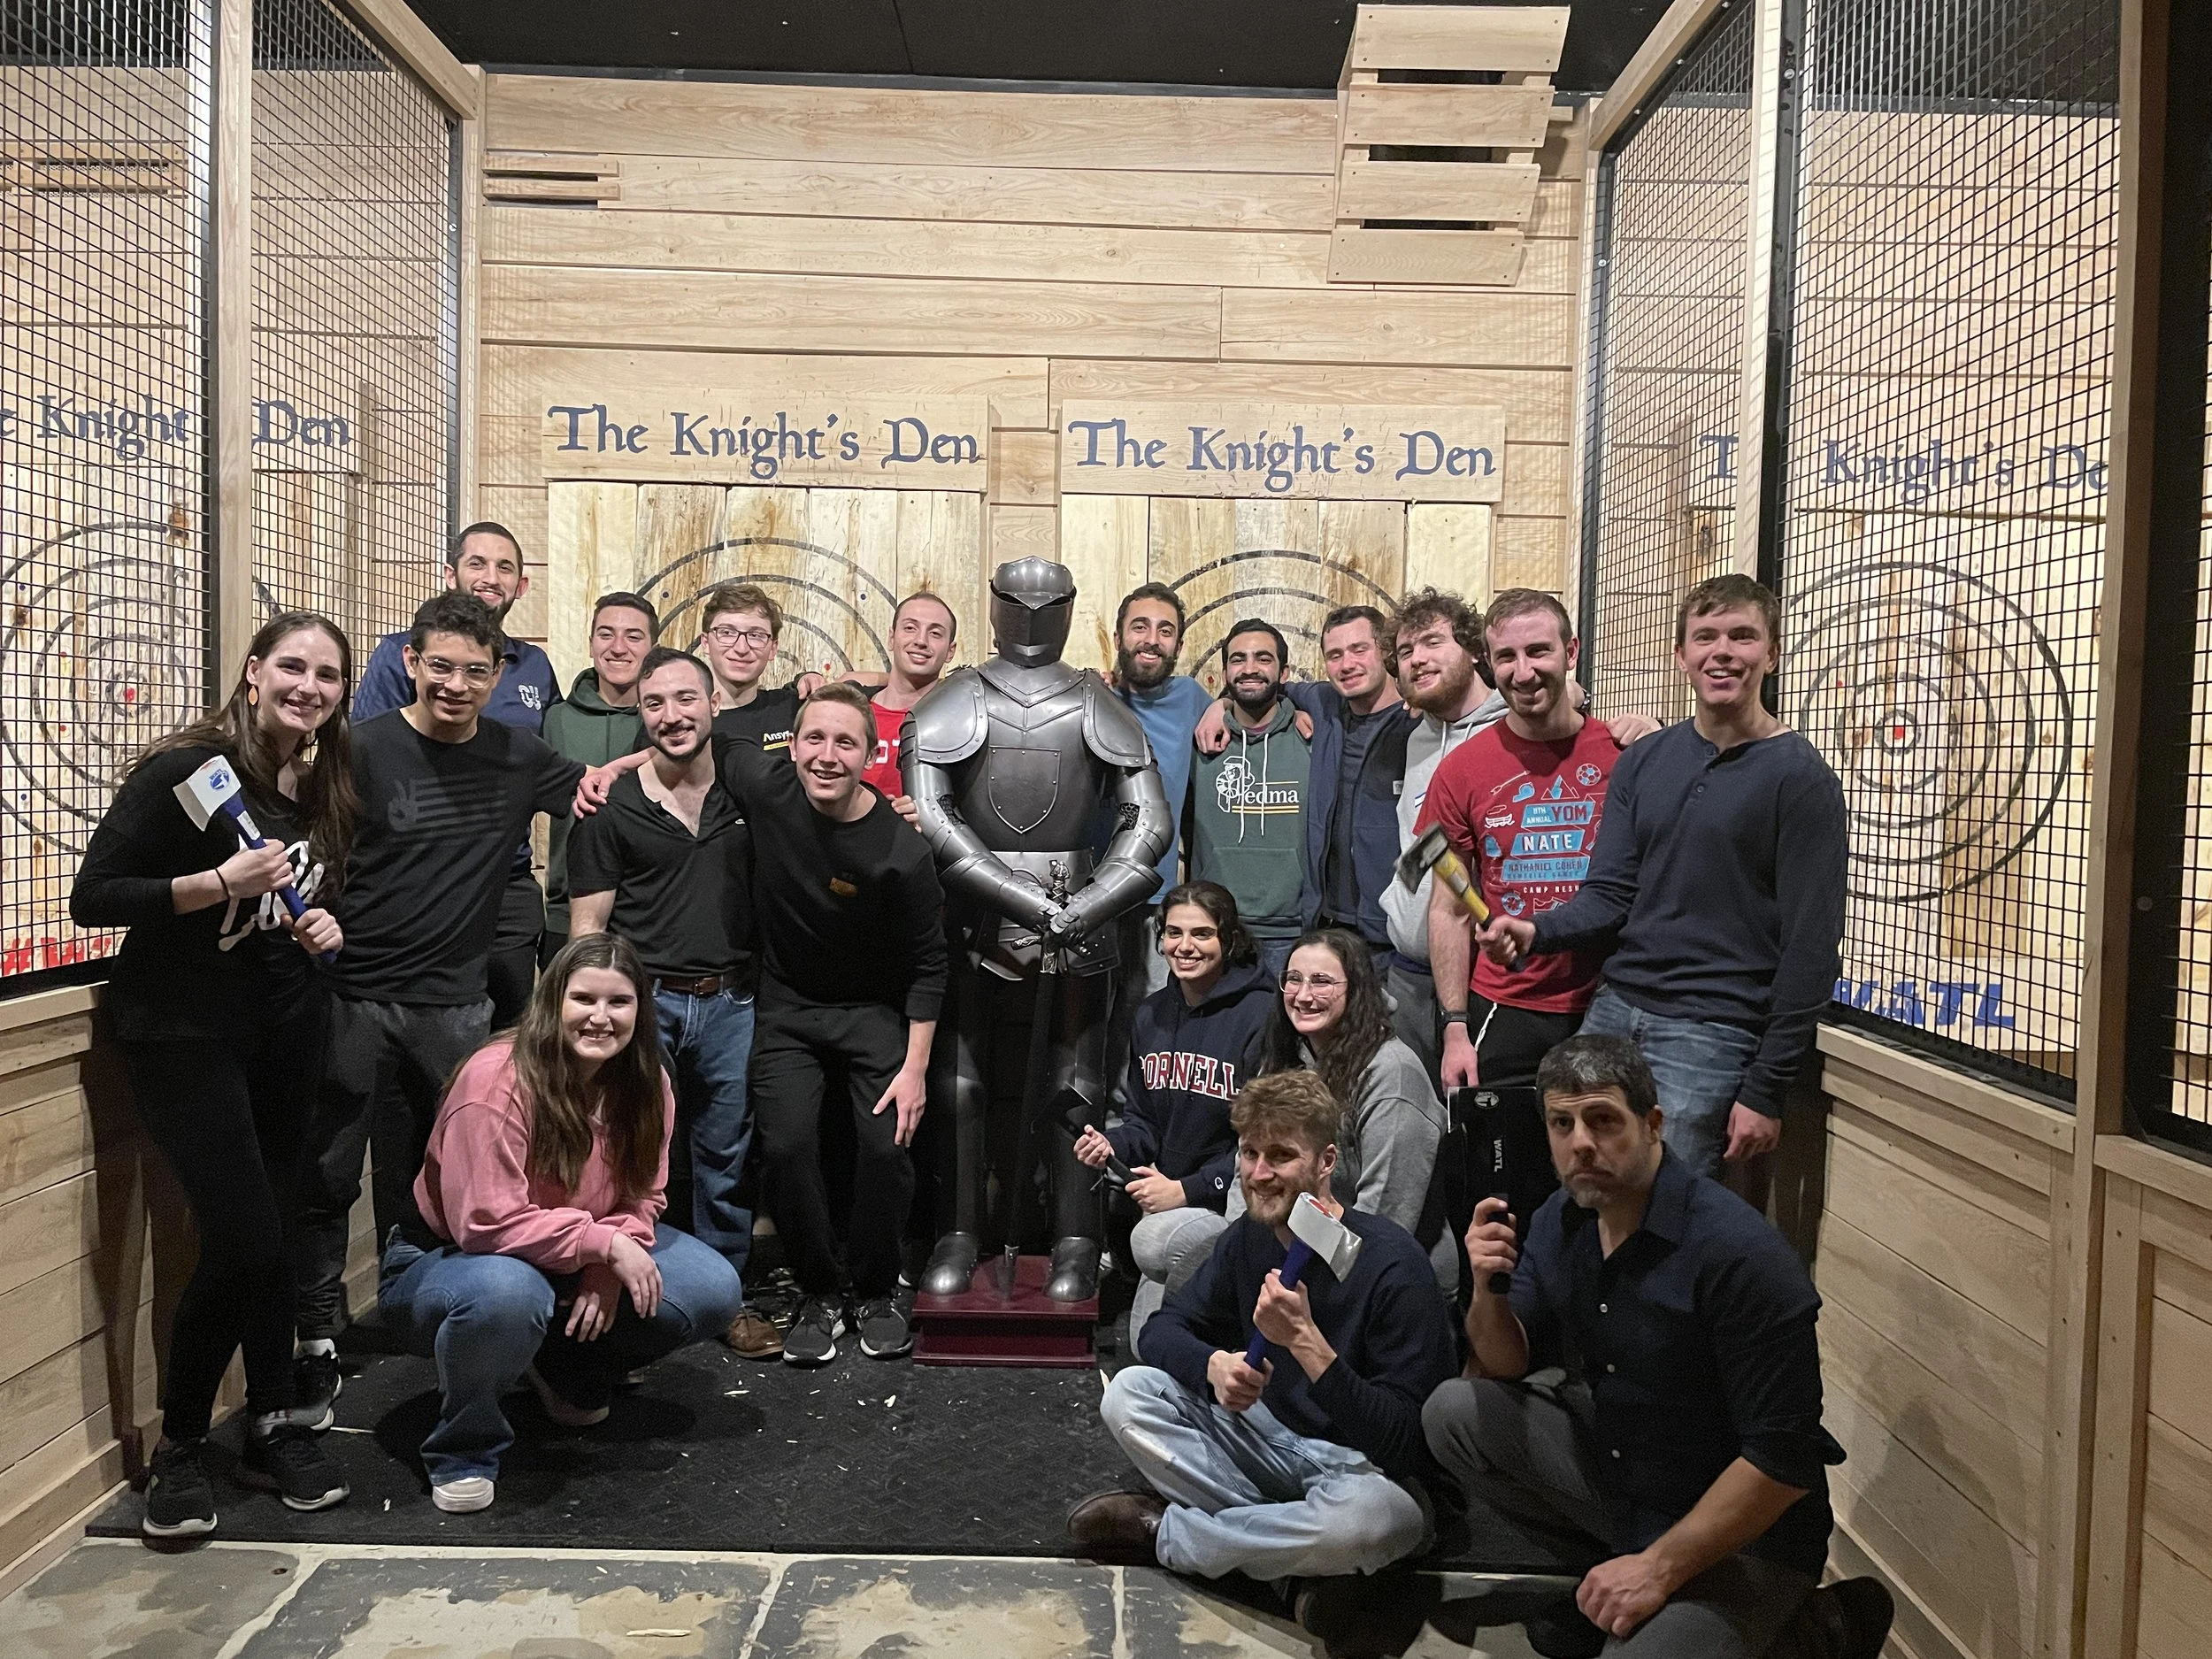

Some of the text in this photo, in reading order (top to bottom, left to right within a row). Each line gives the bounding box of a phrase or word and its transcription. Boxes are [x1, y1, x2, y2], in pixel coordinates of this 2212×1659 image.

[547, 403, 981, 479] The Knight's Den
[1068, 418, 1496, 493] The Knight's Den
[1819, 439, 2110, 505] Knight's De
[763, 730, 790, 741] Ansy
[1551, 804, 1587, 822] YOM
[1523, 833, 1573, 851] NATE
[1139, 1051, 1241, 1102] ORNELL
[1493, 1139, 1503, 1172] WATL
